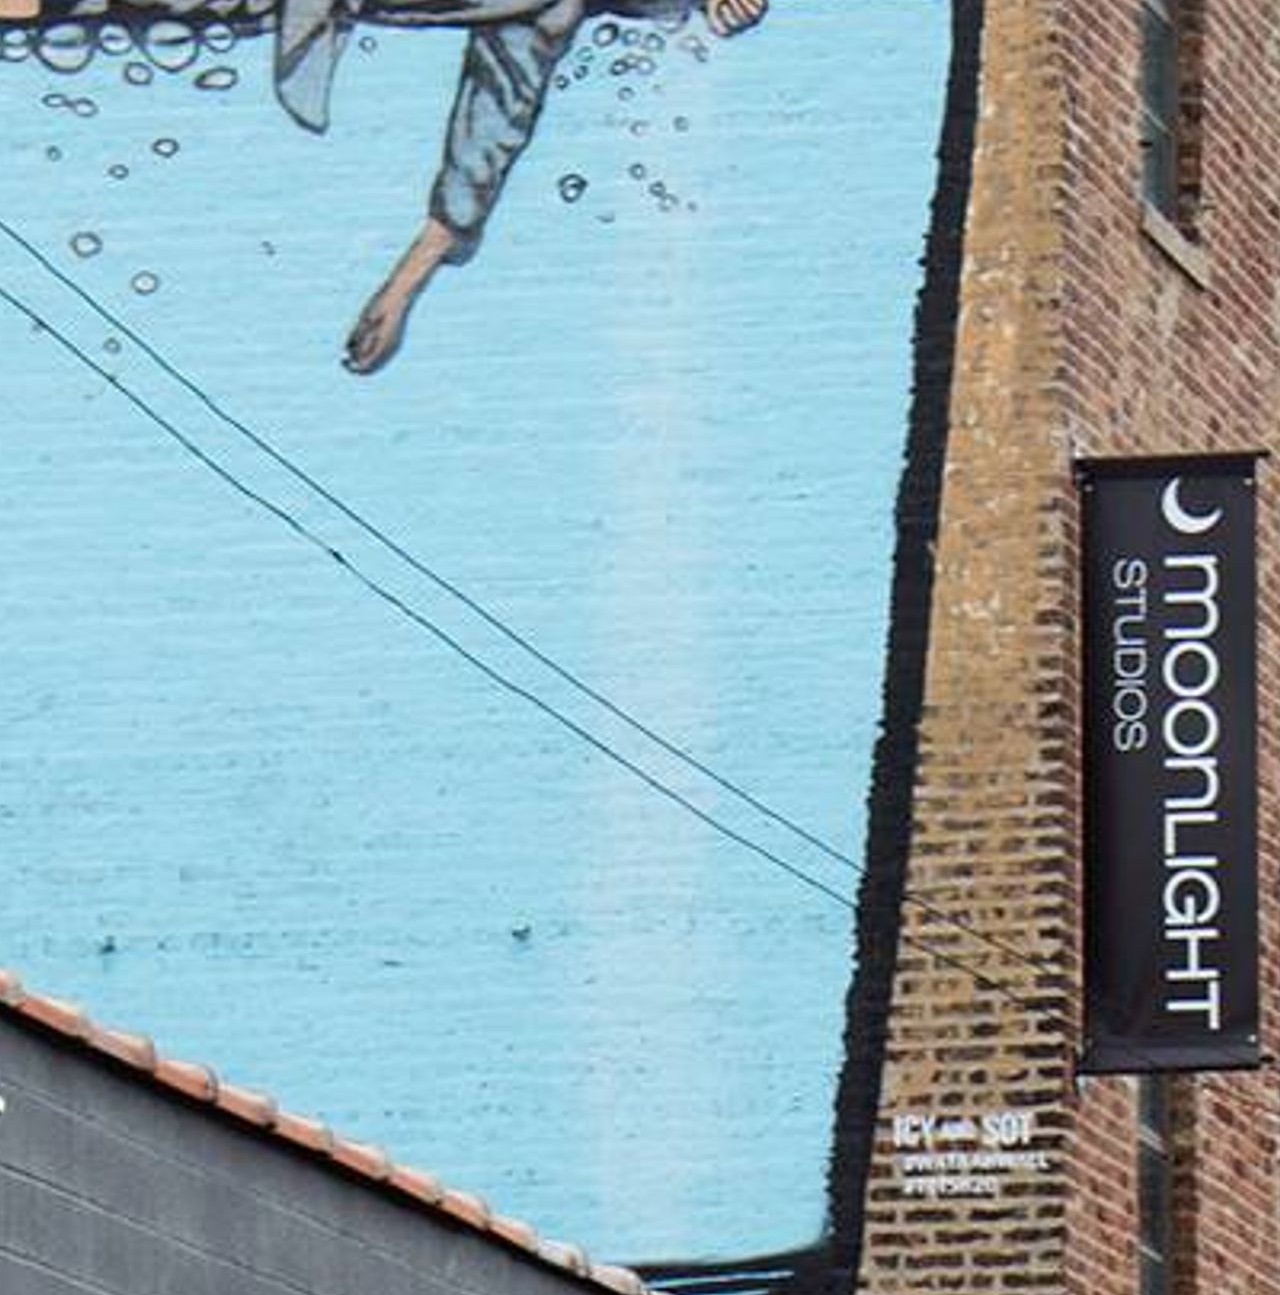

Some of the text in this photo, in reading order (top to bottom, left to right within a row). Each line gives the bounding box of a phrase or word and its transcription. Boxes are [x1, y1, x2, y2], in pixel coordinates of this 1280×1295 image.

[1114, 560, 1147, 751] STUDIOS
[892, 1116, 935, 1148] ICY
[981, 1112, 1031, 1145] SOT
